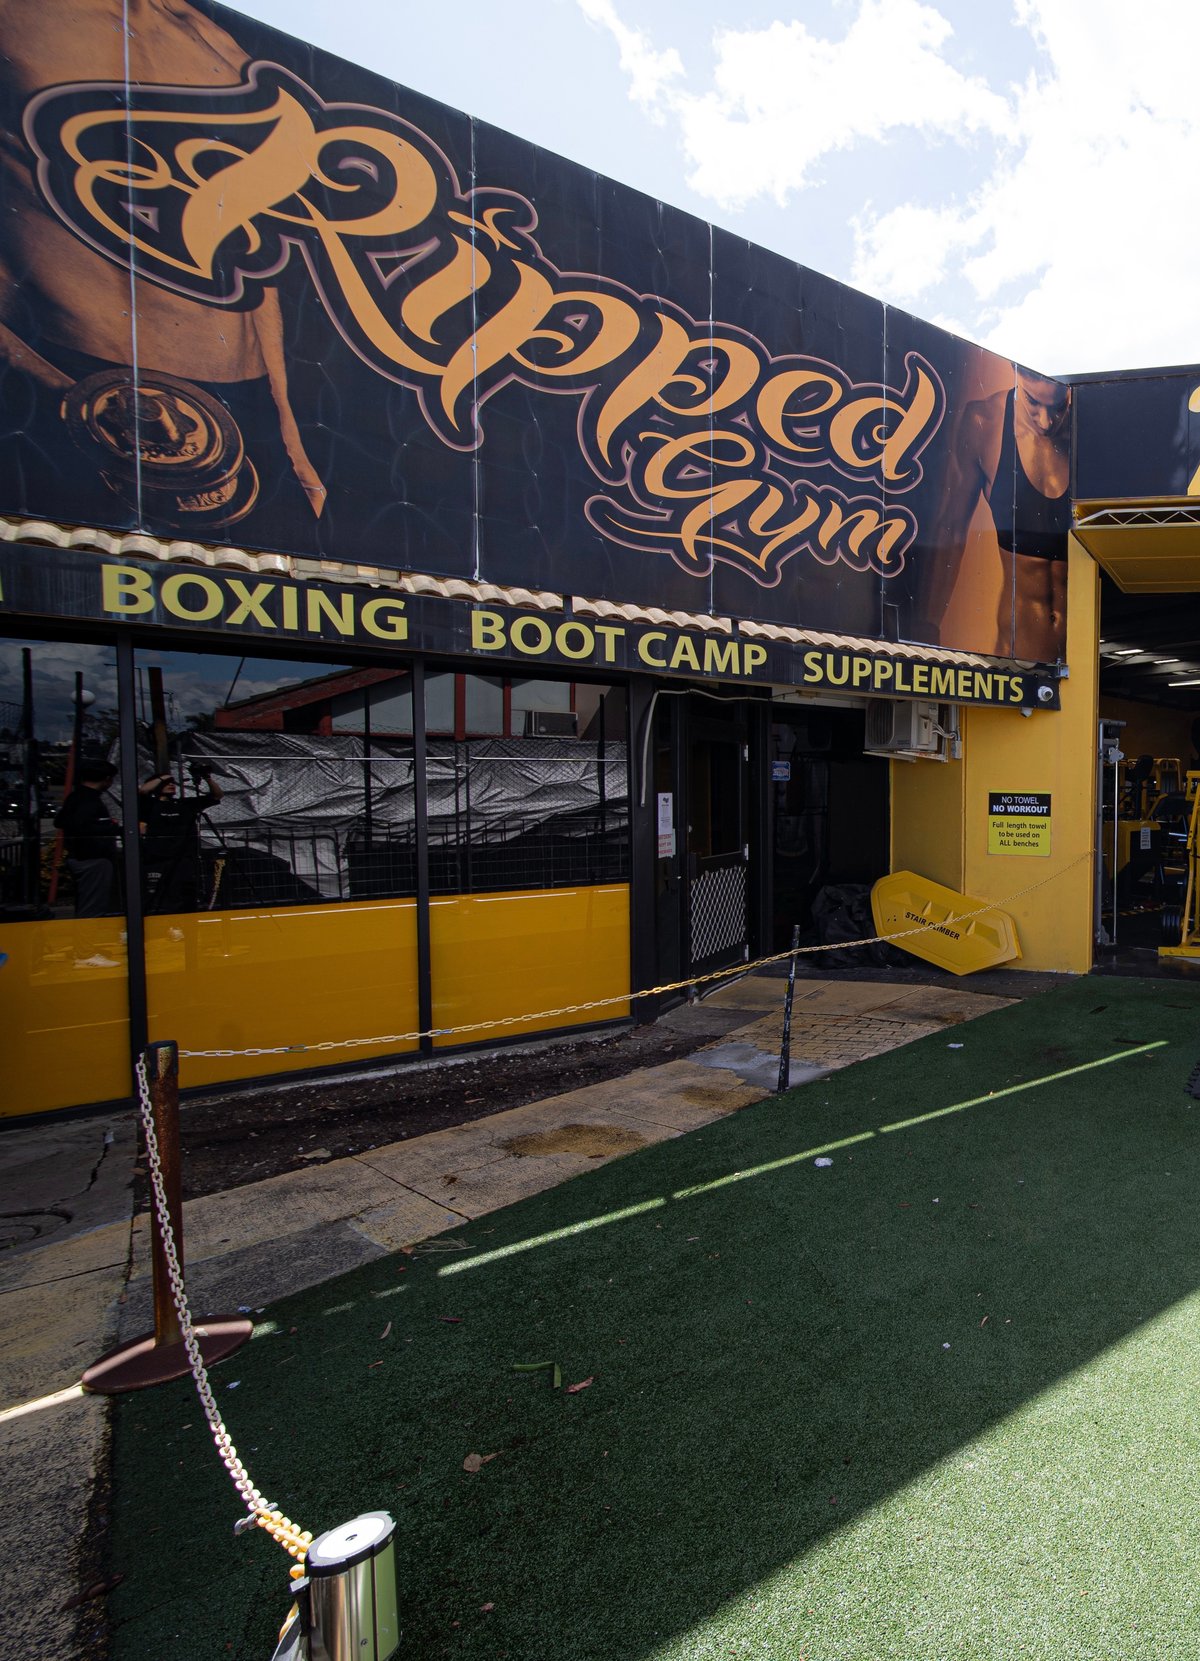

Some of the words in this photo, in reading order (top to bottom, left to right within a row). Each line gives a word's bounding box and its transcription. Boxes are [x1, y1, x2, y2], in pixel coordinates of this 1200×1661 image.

[60, 85, 935, 481] Ripped
[603, 430, 906, 571] Gym
[101, 563, 409, 641] BOXING
[471, 610, 626, 663] BOOT
[637, 631, 769, 676] CAMP
[803, 652, 1024, 704] SUPPLEMENTS
[992, 804, 1005, 812] NO
[1007, 805, 1048, 813] WORKOUT
[1001, 796, 1013, 804] NO
[1014, 796, 1039, 804] TOWEL
[1006, 821, 1027, 830] length
[1013, 840, 1039, 848] benches
[905, 911, 927, 926] STAIR
